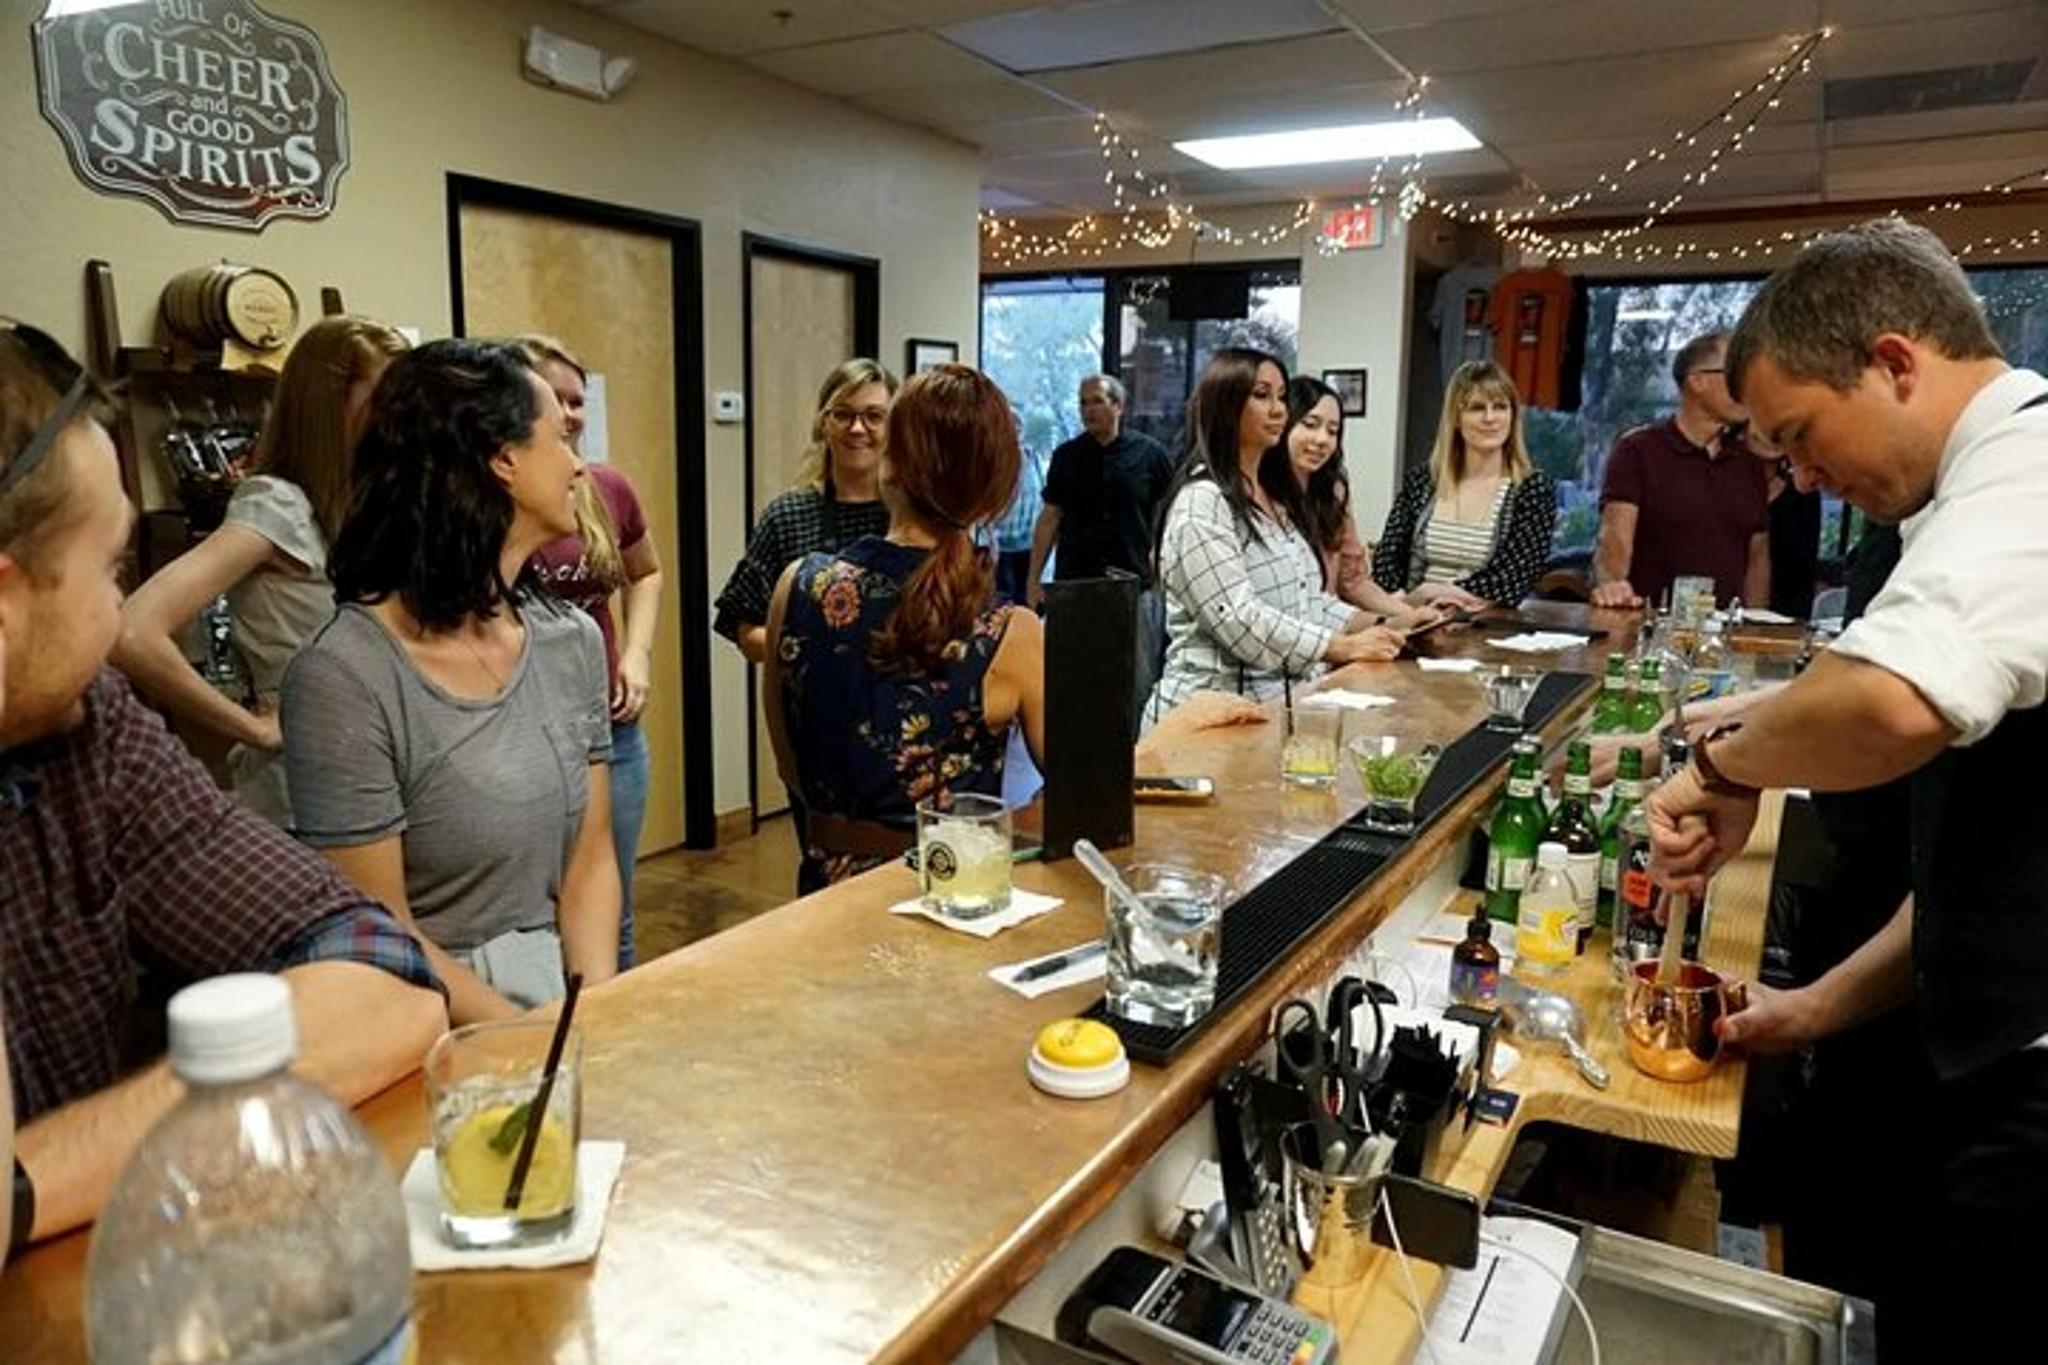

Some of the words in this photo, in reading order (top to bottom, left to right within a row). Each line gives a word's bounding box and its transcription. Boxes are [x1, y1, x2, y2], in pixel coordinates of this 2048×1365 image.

[156, 0, 212, 25] FULL
[223, 11, 255, 39] OF
[103, 22, 299, 112] CHEER
[190, 94, 229, 115] and
[91, 98, 322, 190] SPIRITS
[166, 110, 255, 144] GOOD
